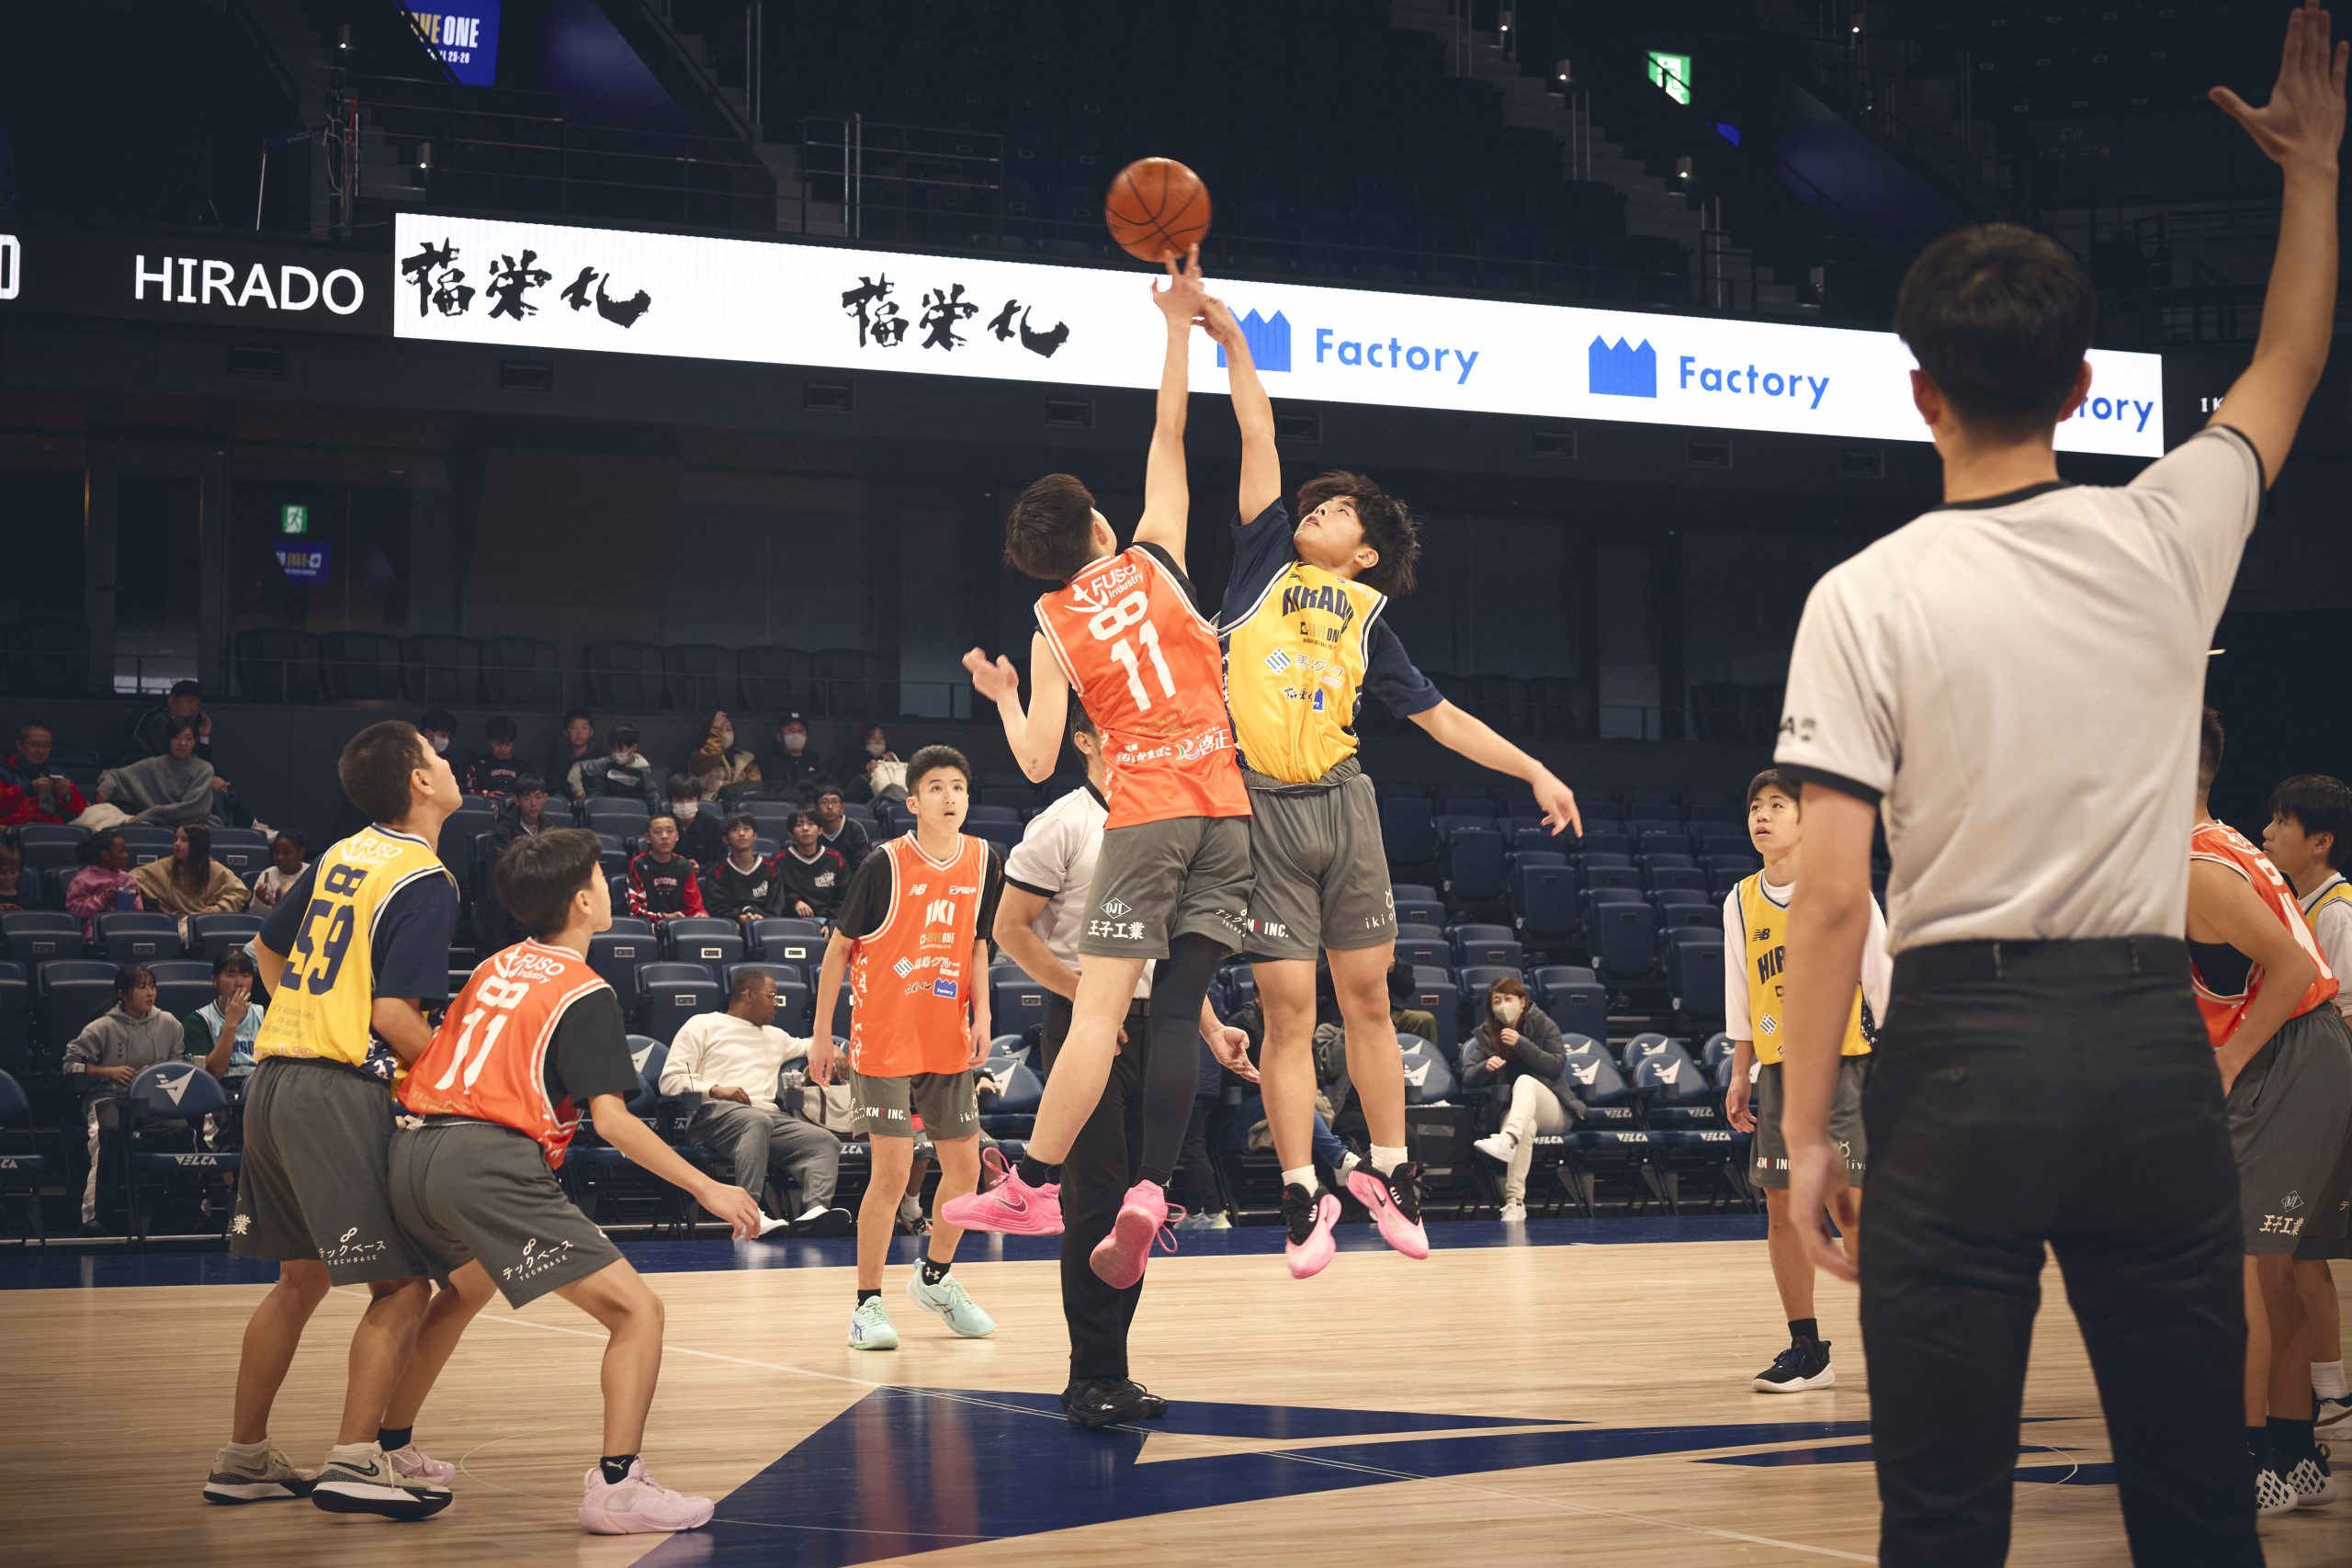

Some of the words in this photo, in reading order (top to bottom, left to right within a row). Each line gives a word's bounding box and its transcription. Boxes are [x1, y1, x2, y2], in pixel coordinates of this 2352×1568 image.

[443, 16, 480, 48] ONE
[135, 254, 365, 315] HIRADO
[1315, 328, 1479, 385] Factory
[1679, 355, 1831, 410] Factory
[1091, 563, 1136, 597] FUSO
[1108, 572, 1144, 599] Industry
[1110, 619, 1176, 712] 11
[359, 837, 403, 859] FUSO
[925, 898, 956, 928] IKI
[1106, 902, 1123, 914] OJI
[1088, 919, 1145, 940] 王子工業
[1264, 921, 1289, 938] INC.
[279, 897, 354, 996] 59
[514, 953, 566, 976] FUSO
[516, 968, 551, 984] Industry
[1758, 945, 1785, 985] HIR
[435, 1008, 508, 1094] 11
[888, 1108, 906, 1120] INC.
[1616, 1133, 1649, 1142] VELCA
[1700, 1132, 1732, 1142] VELCA
[175, 1156, 217, 1166] VELCA
[840, 1145, 864, 1155] LCA
[2259, 1213, 2304, 1236] 王子工業
[319, 1241, 386, 1258] テックベース
[327, 1255, 378, 1266] TECHBASE
[503, 1240, 573, 1280] テックベース
[519, 1255, 568, 1281] TECHBASE
